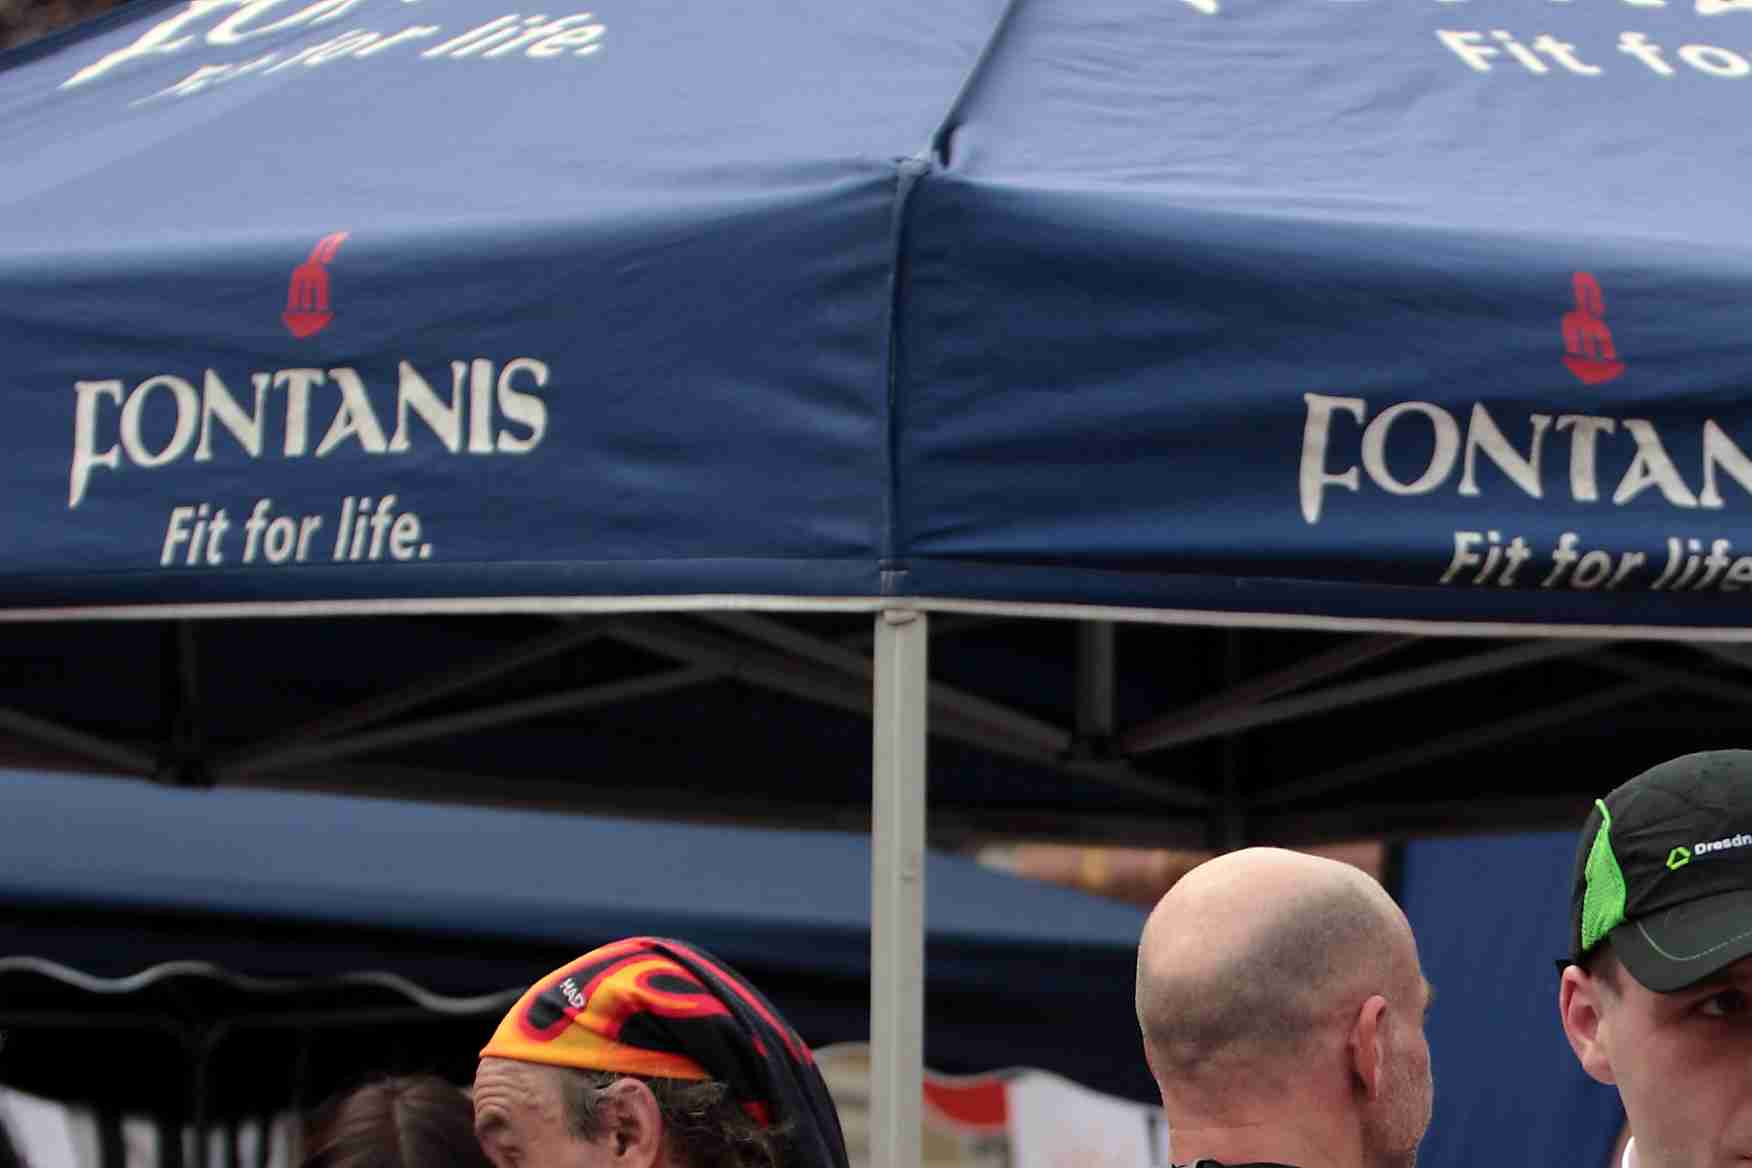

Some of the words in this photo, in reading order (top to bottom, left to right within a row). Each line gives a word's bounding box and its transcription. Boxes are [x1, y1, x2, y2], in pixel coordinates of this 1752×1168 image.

[1436, 28, 1603, 77] Fit
[69, 357, 549, 508] FONTANIS
[160, 503, 229, 566] Fit
[242, 498, 322, 565] for
[333, 494, 432, 561] life.
[1439, 530, 1532, 586] Fit
[1541, 531, 1646, 589] for
[560, 977, 585, 1008] HAD
